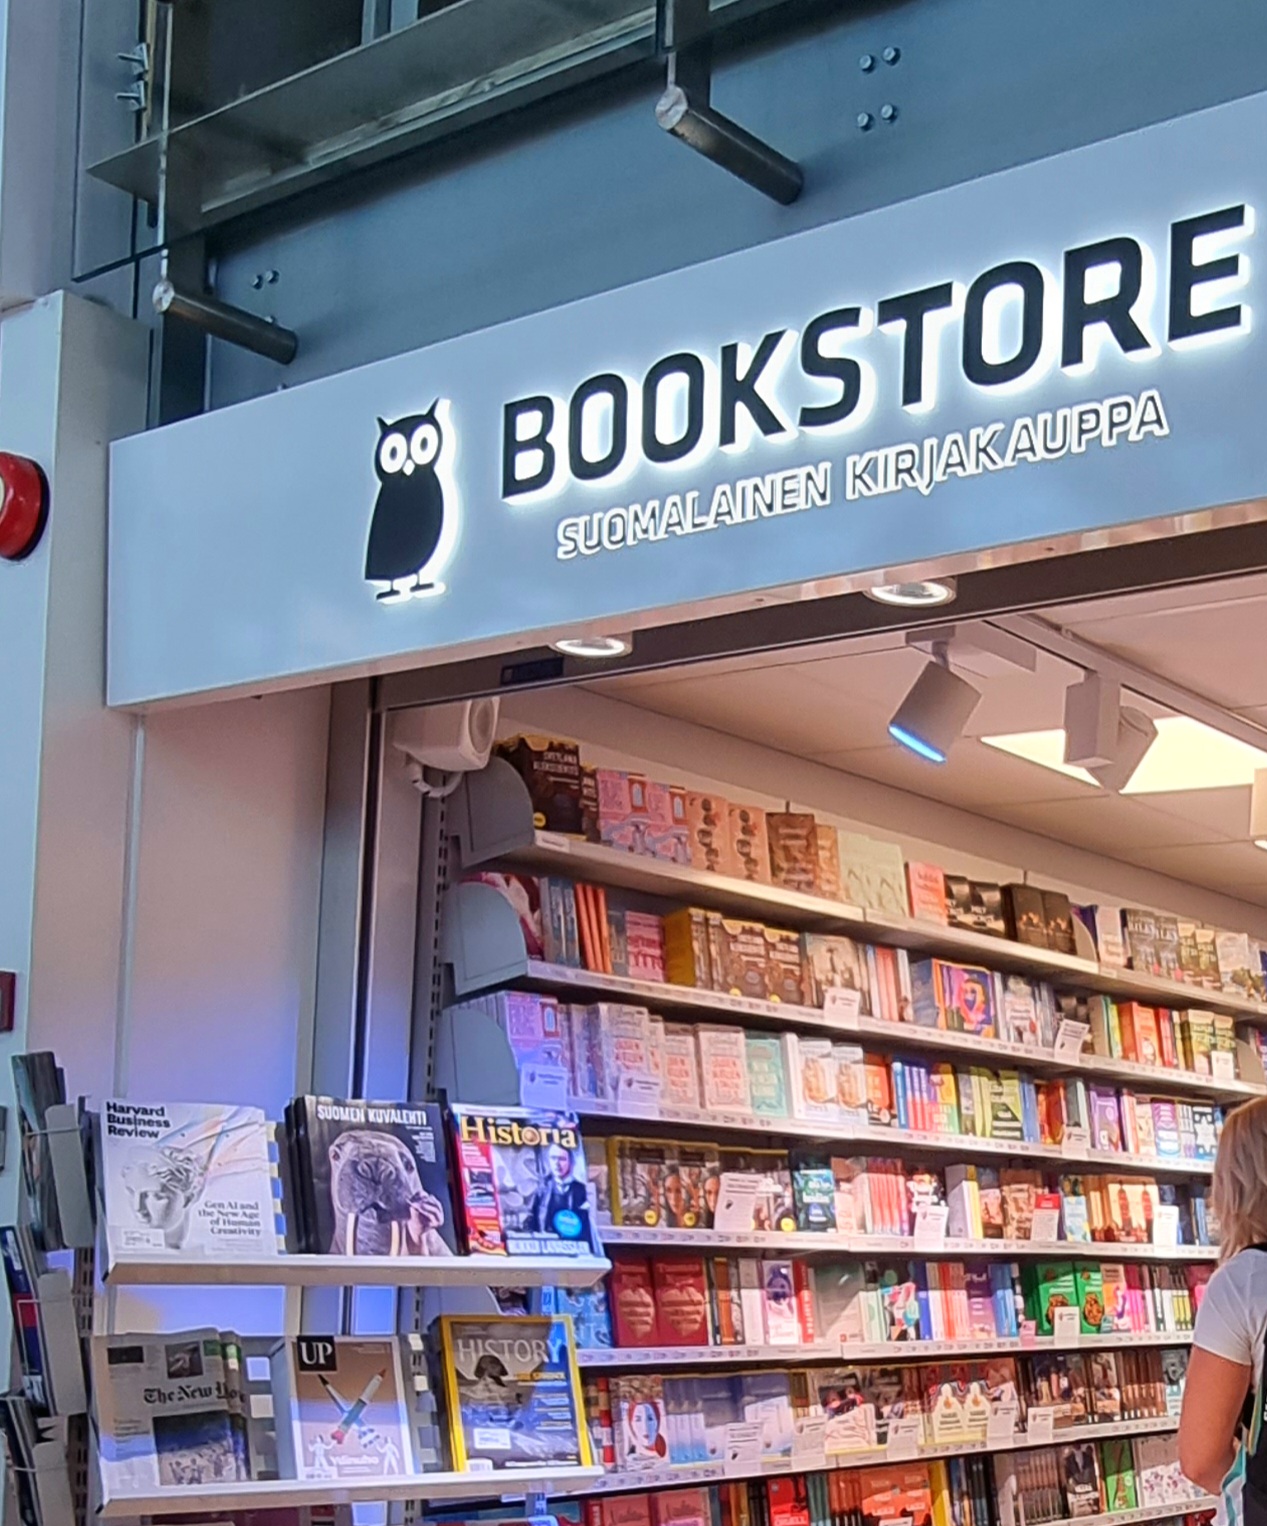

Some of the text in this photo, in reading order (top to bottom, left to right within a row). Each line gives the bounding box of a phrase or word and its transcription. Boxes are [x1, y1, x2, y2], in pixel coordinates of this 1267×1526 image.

[500, 203, 1254, 503] BOOKSTORE
[556, 390, 1169, 562] SUOMALAINEN KIRJAKAUPPA
[106, 1101, 165, 1117] Harvard
[317, 1104, 426, 1126] SUOMEN KUVALEHTI
[107, 1113, 171, 1128] Business
[108, 1126, 160, 1140] Review
[461, 1115, 577, 1149] Historia
[210, 1226, 262, 1237] Creativity
[301, 1341, 333, 1364] UP
[457, 1338, 561, 1363] HISTORY
[144, 1388, 175, 1404] The
